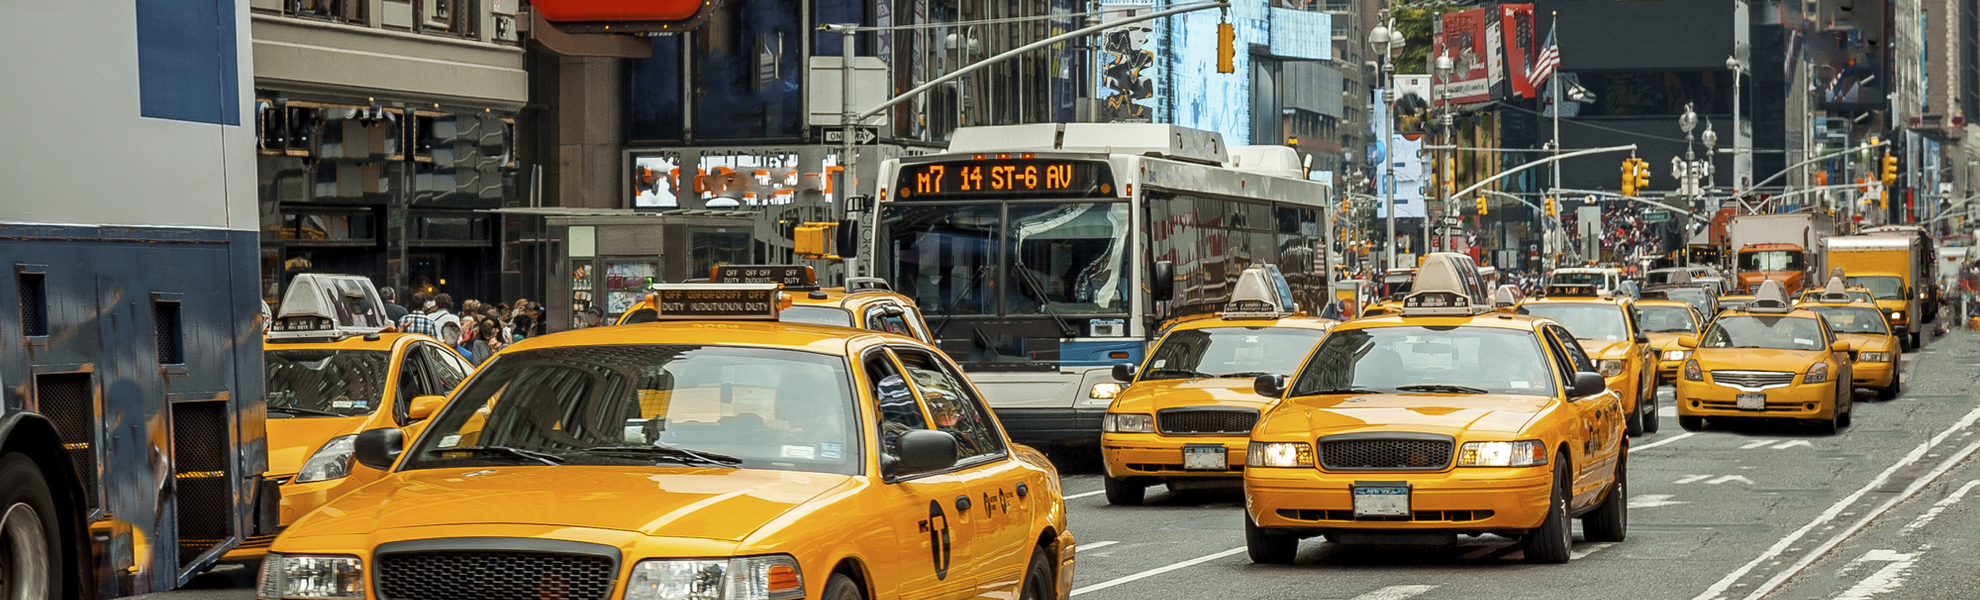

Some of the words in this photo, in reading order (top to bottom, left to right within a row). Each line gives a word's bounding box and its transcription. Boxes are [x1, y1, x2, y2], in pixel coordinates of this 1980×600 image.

[918, 166, 944, 193] M7
[961, 166, 982, 190] 14
[991, 166, 1036, 190] ST-6
[1047, 165, 1072, 189] AV
[726, 269, 739, 277] OFF
[785, 269, 798, 277] OFF
[784, 277, 801, 285] DUTY
[664, 291, 682, 300] OFF
[747, 291, 766, 300] OFF
[662, 302, 685, 312] DUTY
[745, 302, 769, 312] DUTY
